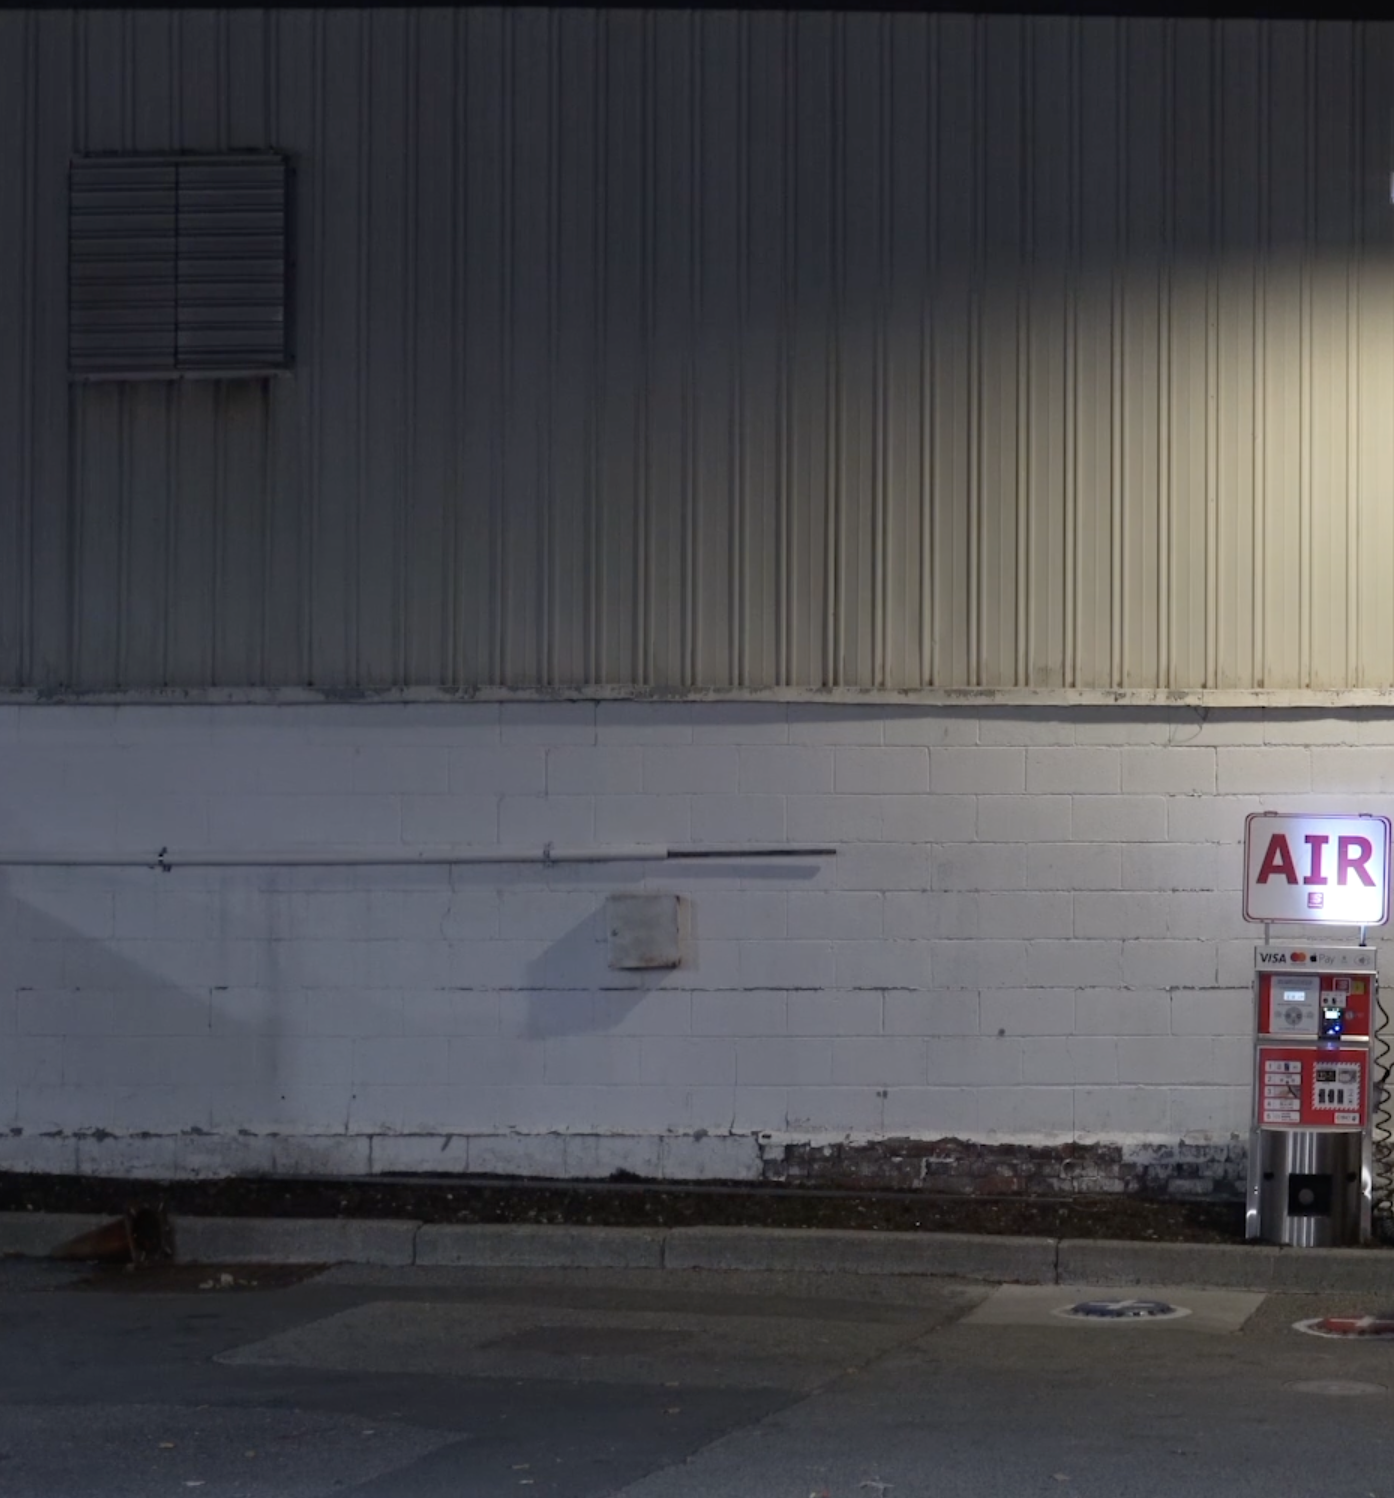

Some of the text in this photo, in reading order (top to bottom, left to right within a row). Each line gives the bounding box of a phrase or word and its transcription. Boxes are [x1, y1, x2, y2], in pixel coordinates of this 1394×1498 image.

[1256, 833, 1375, 886] AIR
[1259, 953, 1287, 964] VISA
[1319, 953, 1336, 966] Pay
